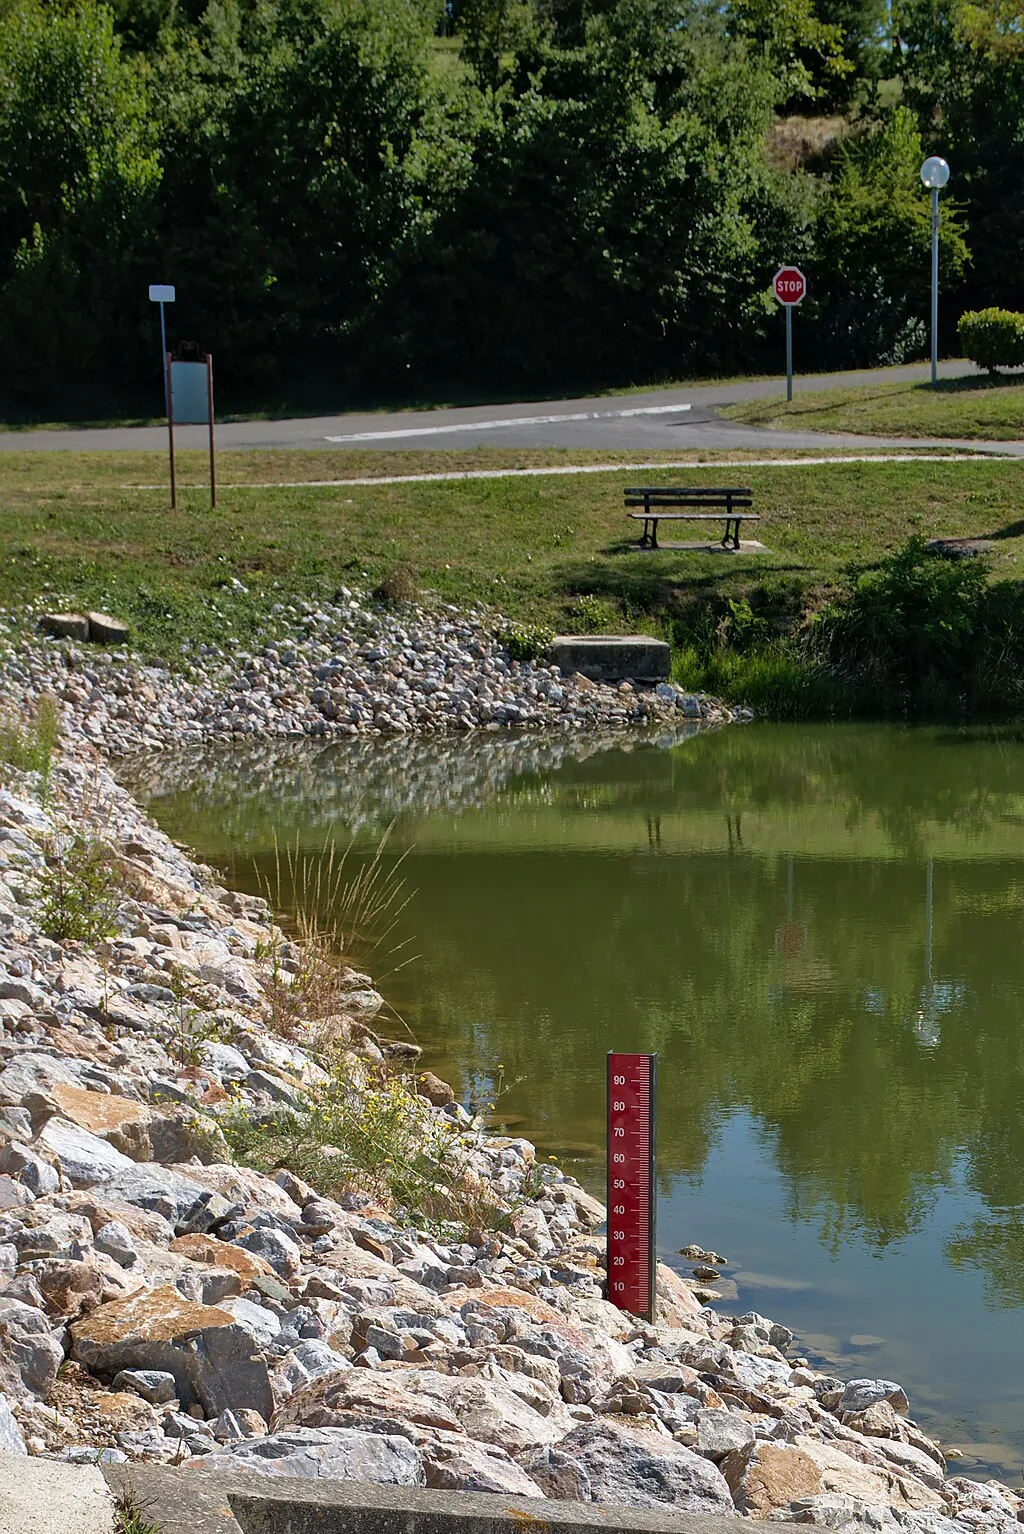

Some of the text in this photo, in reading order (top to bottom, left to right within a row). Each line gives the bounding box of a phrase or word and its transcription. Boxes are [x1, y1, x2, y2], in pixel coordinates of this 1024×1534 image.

[777, 281, 802, 292] STOP
[613, 1075, 625, 1085] 90
[613, 1101, 625, 1111] 80
[613, 1127, 625, 1137] 70
[613, 1153, 625, 1163] 60
[613, 1179, 625, 1189] 50
[613, 1205, 625, 1215] 40
[613, 1230, 625, 1240] 30
[613, 1256, 625, 1266] 20
[613, 1281, 625, 1291] 10
